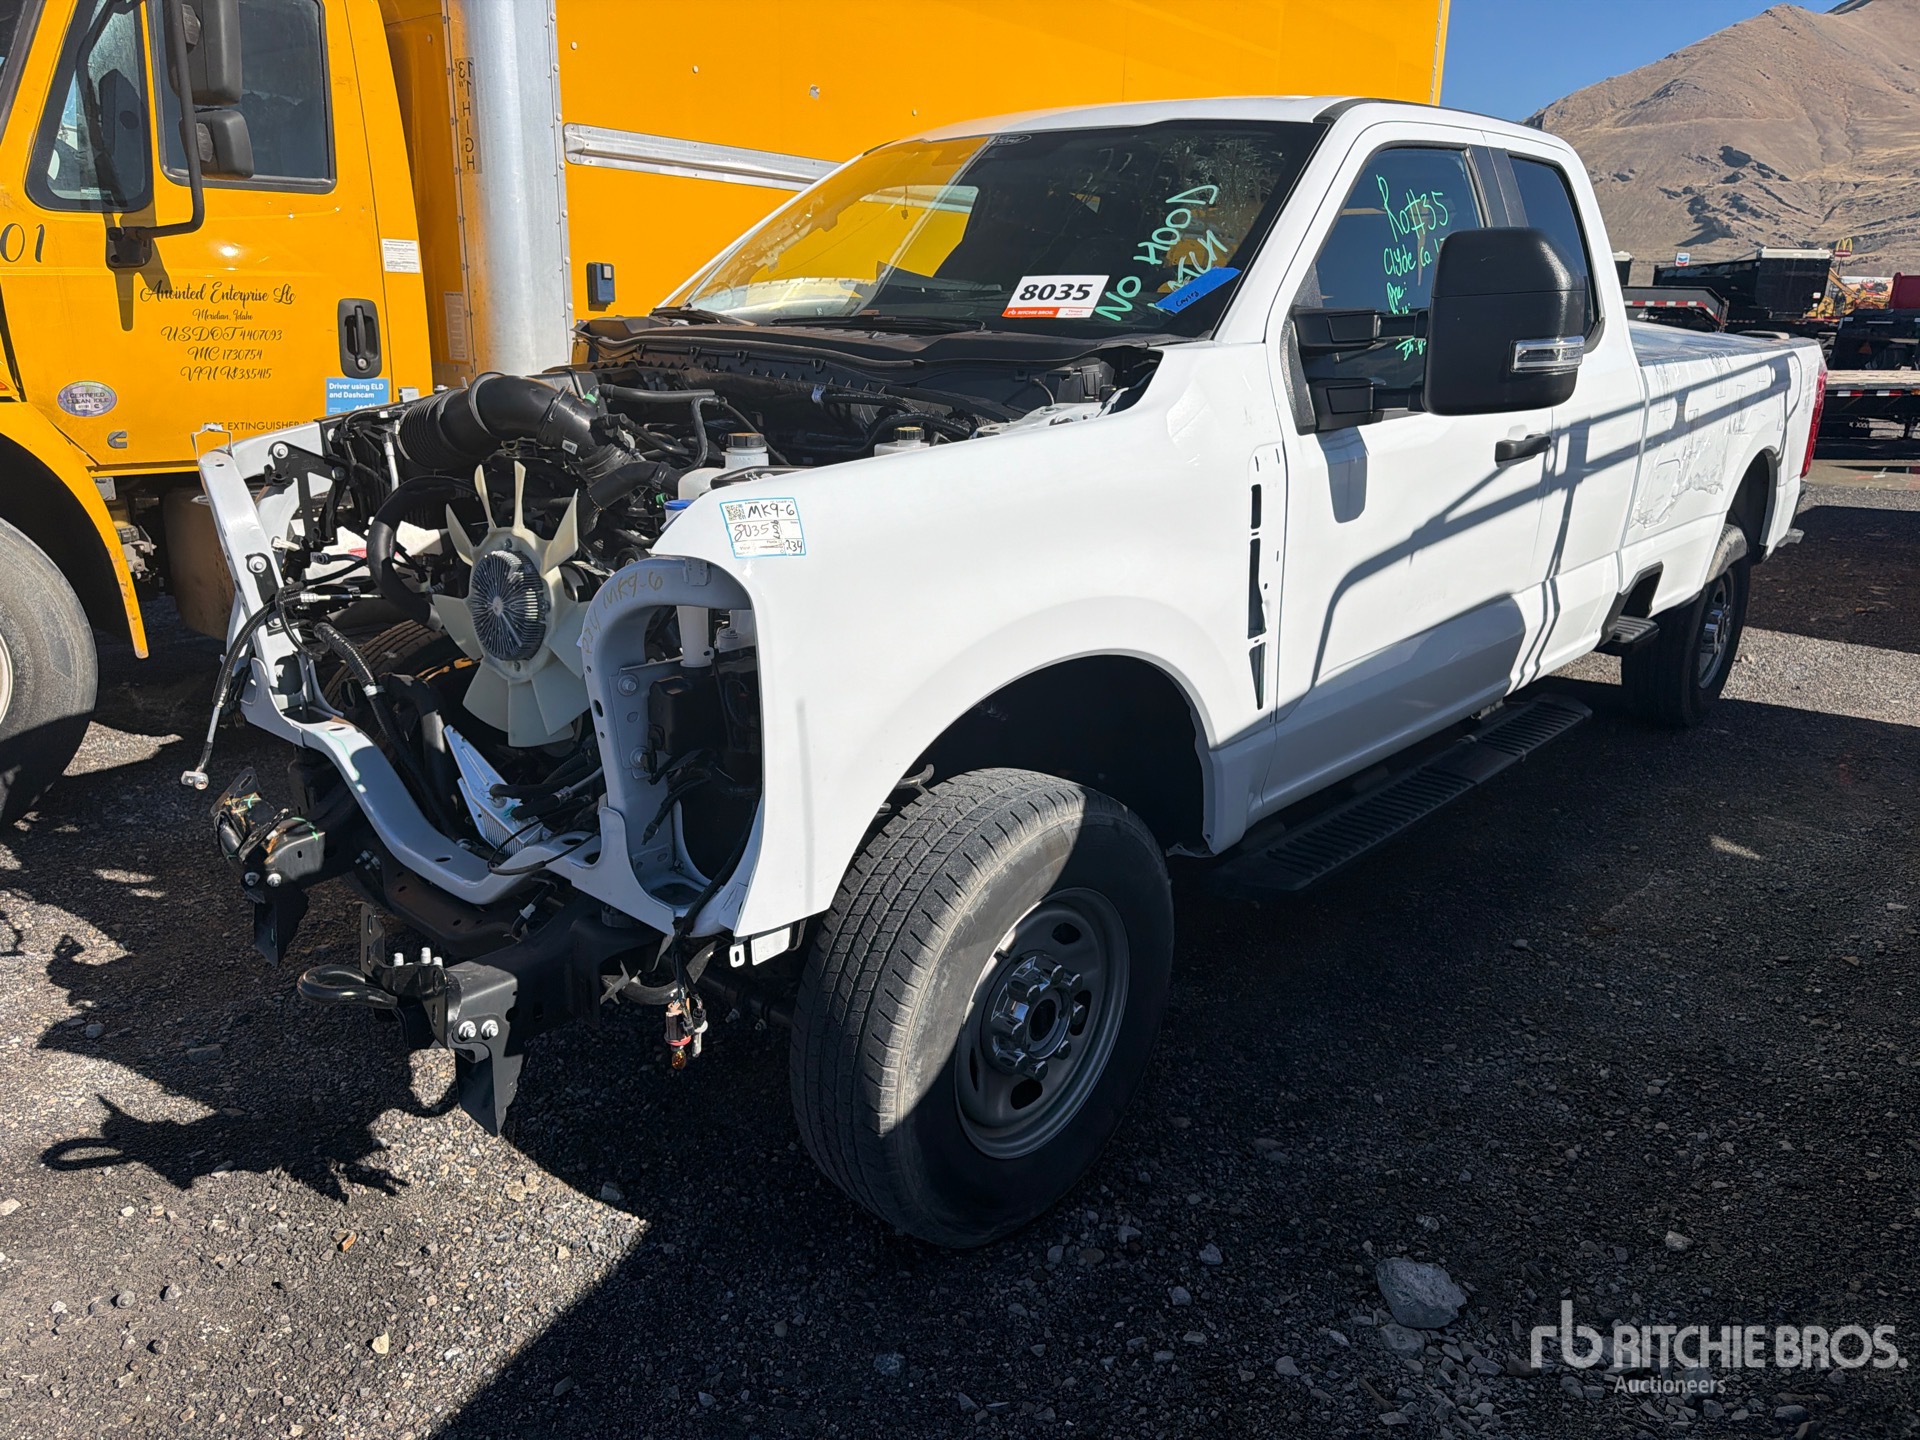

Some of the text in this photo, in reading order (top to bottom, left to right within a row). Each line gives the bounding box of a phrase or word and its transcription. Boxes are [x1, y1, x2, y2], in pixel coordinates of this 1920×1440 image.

[1095, 184, 1220, 322] NO HOOD
[140, 280, 207, 303] Anointed
[209, 281, 269, 309] Enterprise
[1019, 284, 1094, 301] 8035
[161, 326, 242, 342] USDOT
[187, 346, 263, 361] MC 1730754
[180, 366, 219, 381] VIN
[344, 391, 375, 399] Dashcam
[351, 383, 370, 392] using
